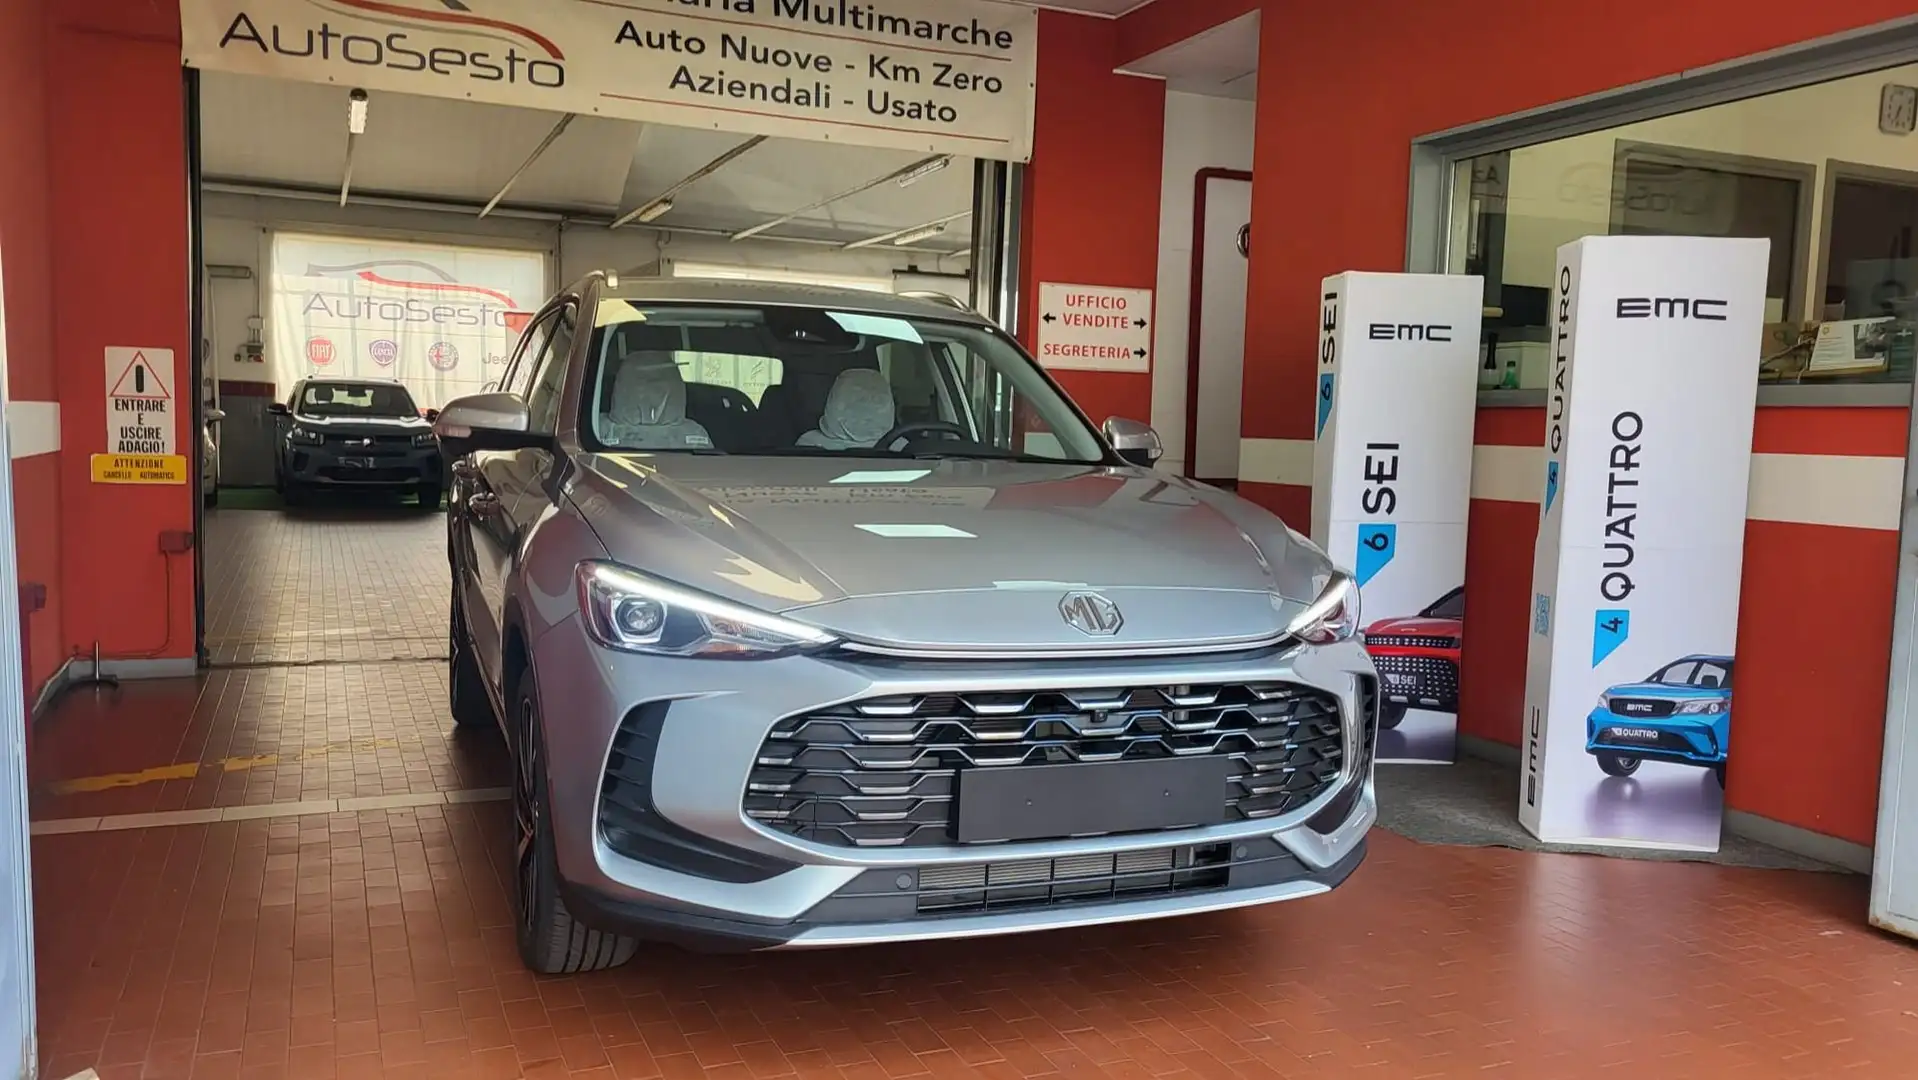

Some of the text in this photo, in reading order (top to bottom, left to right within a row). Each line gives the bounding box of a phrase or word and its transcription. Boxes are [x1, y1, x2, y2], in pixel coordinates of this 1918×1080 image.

[773, 0, 1013, 49] Multimarche
[219, 12, 565, 88] AutoSesto
[614, 20, 706, 54] Auto
[721, 33, 832, 73] Nuove
[868, 54, 920, 84] Km
[932, 62, 1002, 93] Zero
[669, 65, 830, 109] Aziendali
[867, 89, 957, 122] Usato
[303, 293, 517, 327] AutoSesto
[1066, 294, 1127, 310] UFFICIO
[1616, 298, 1728, 320] EMC
[1062, 313, 1129, 329] VENDITE
[1369, 323, 1452, 342] EMC
[1043, 343, 1131, 359] SEGRETERIA
[1321, 292, 1338, 401] 6 SEI
[482, 352, 509, 365] Jee
[1551, 266, 1571, 454] QUATTRO
[115, 399, 166, 412] ENTRARE
[138, 413, 144, 425] E
[120, 427, 162, 440] USCIRE
[118, 440, 165, 453] ADAGIO!
[114, 458, 164, 469] ATTENZIONE
[1362, 443, 1400, 550] 6 SEI
[1600, 411, 1643, 633] 4 QUATTRO
[1063, 594, 1119, 632] MG
[1400, 674, 1417, 686] SEI
[1622, 728, 1659, 739] QUATTRO
[1527, 706, 1540, 807] EMC
